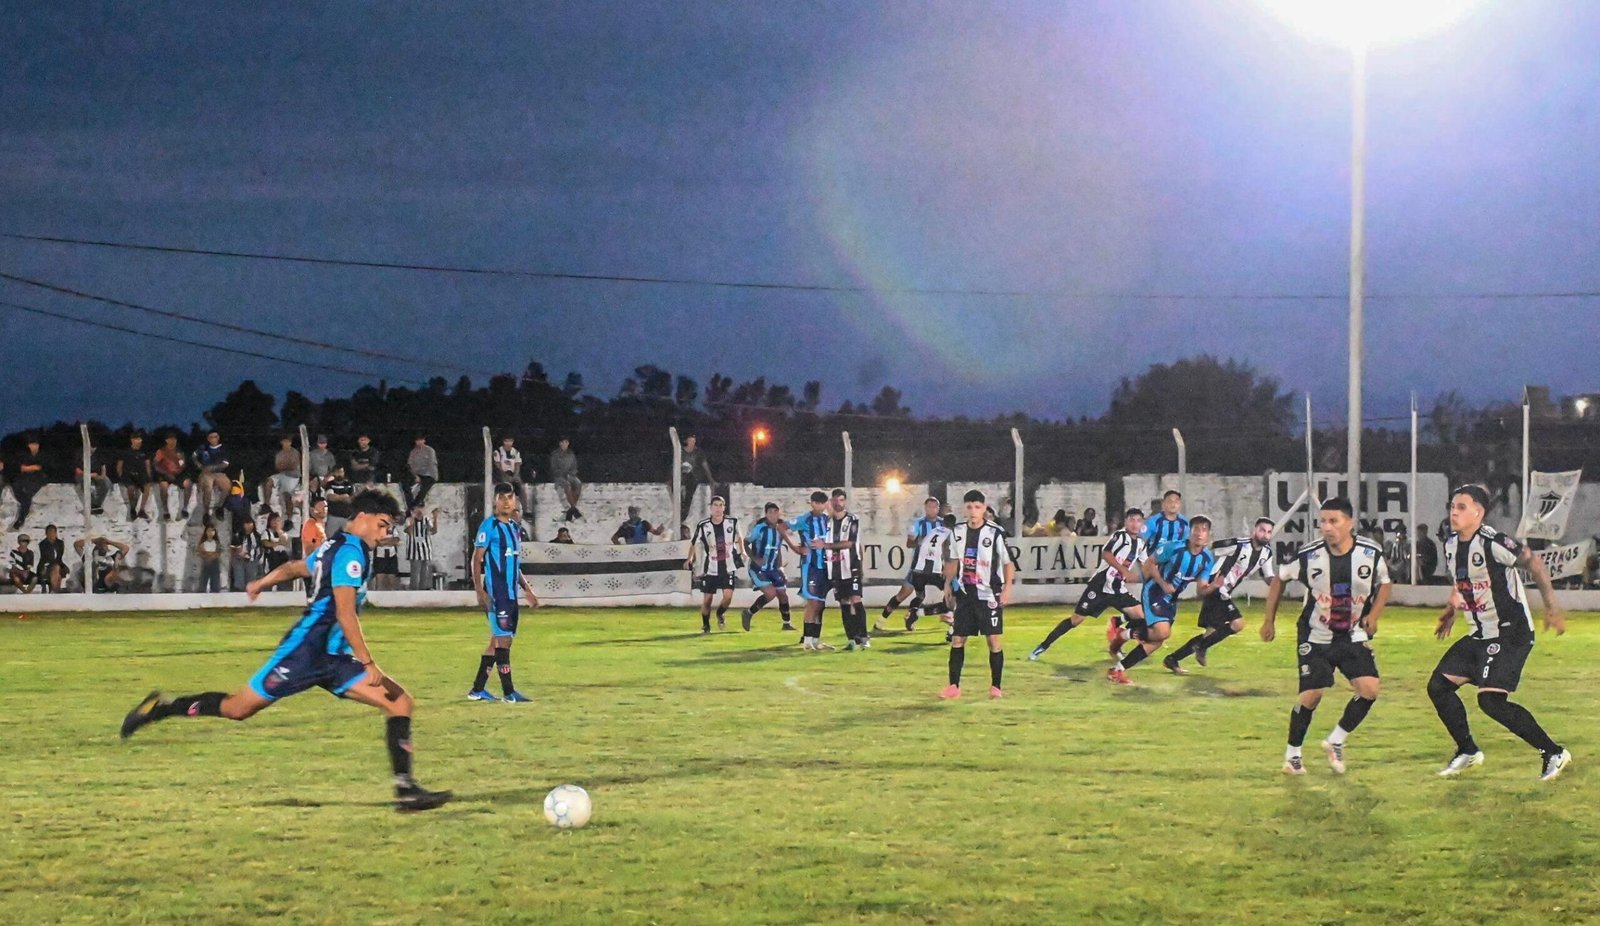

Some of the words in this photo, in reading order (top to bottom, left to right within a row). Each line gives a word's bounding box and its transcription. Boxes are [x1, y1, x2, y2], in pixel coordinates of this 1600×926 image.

[930, 534, 939, 547] 4
[991, 617, 999, 627] 17
[1483, 666, 1490, 678] 8
